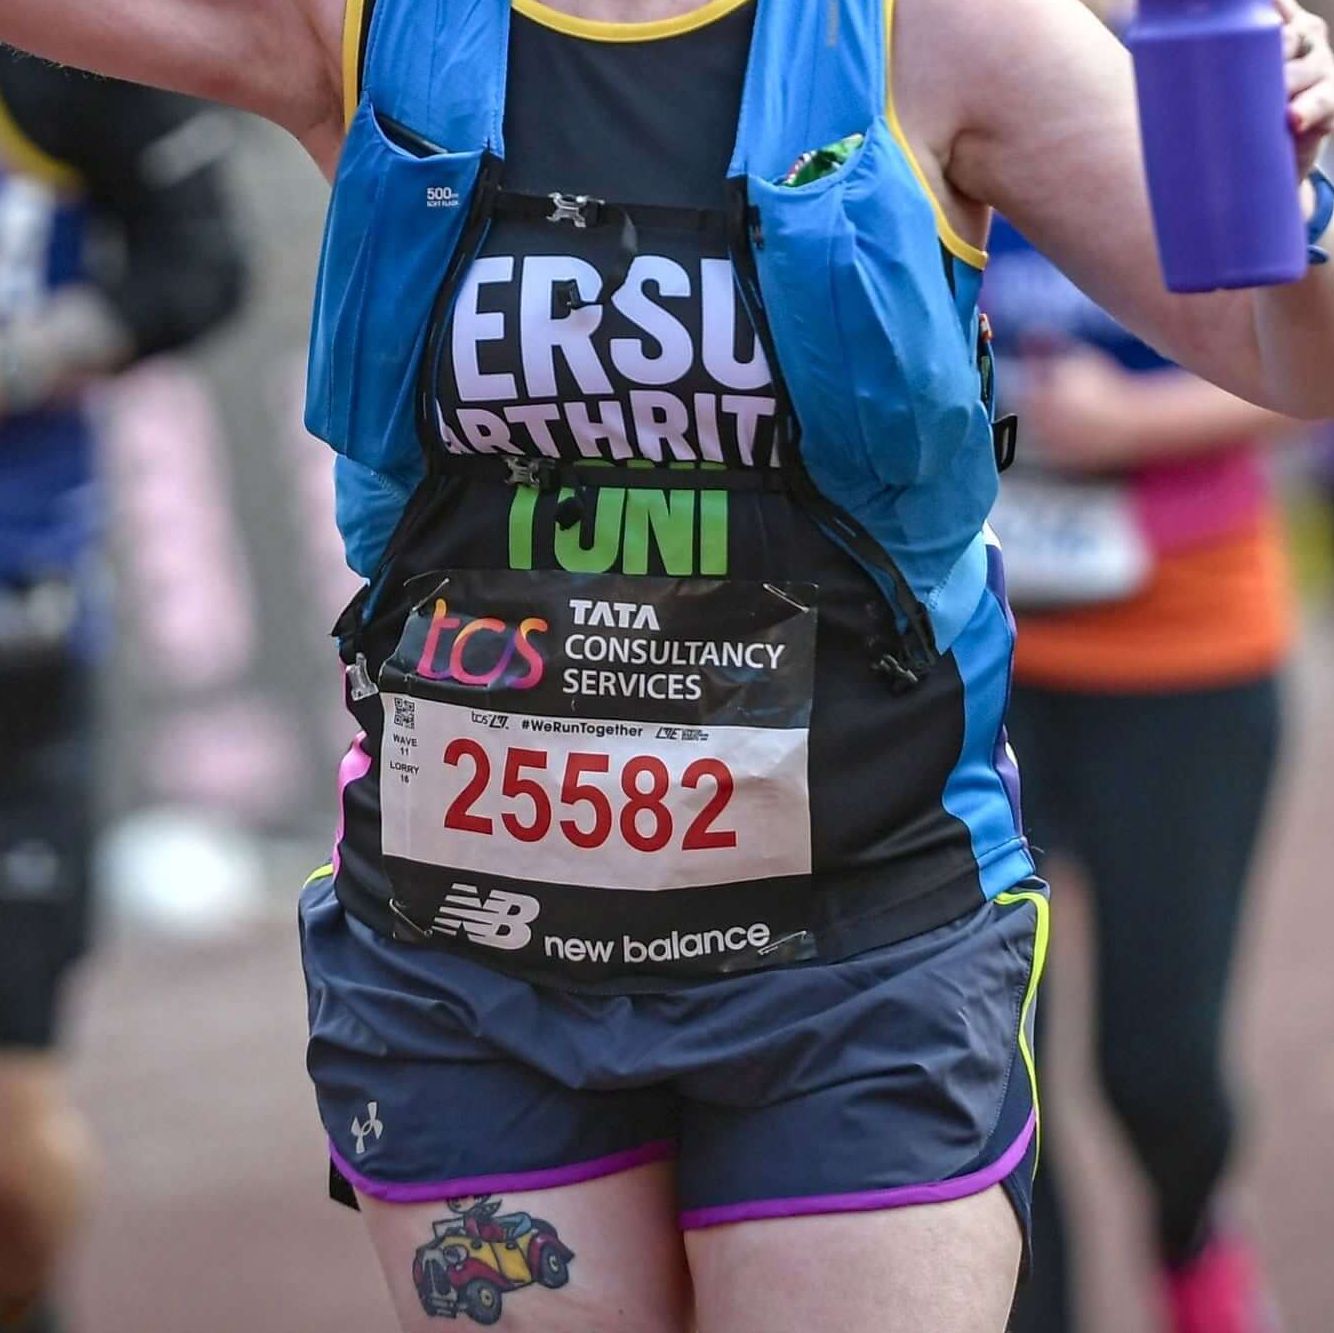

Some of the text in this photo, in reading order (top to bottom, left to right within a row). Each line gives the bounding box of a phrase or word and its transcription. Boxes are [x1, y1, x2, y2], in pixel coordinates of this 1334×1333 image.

[451, 254, 773, 402] ERSU
[569, 599, 660, 632] TATA
[414, 597, 549, 690] tcs
[564, 634, 785, 671] CONSULTANCY
[562, 668, 703, 701] SERVICES
[393, 733, 418, 747] WAVE
[521, 718, 644, 738] #WeRunTogether
[389, 760, 420, 775] LORRY
[442, 737, 737, 853] 25582
[543, 930, 618, 964] new
[623, 922, 771, 964] balance
